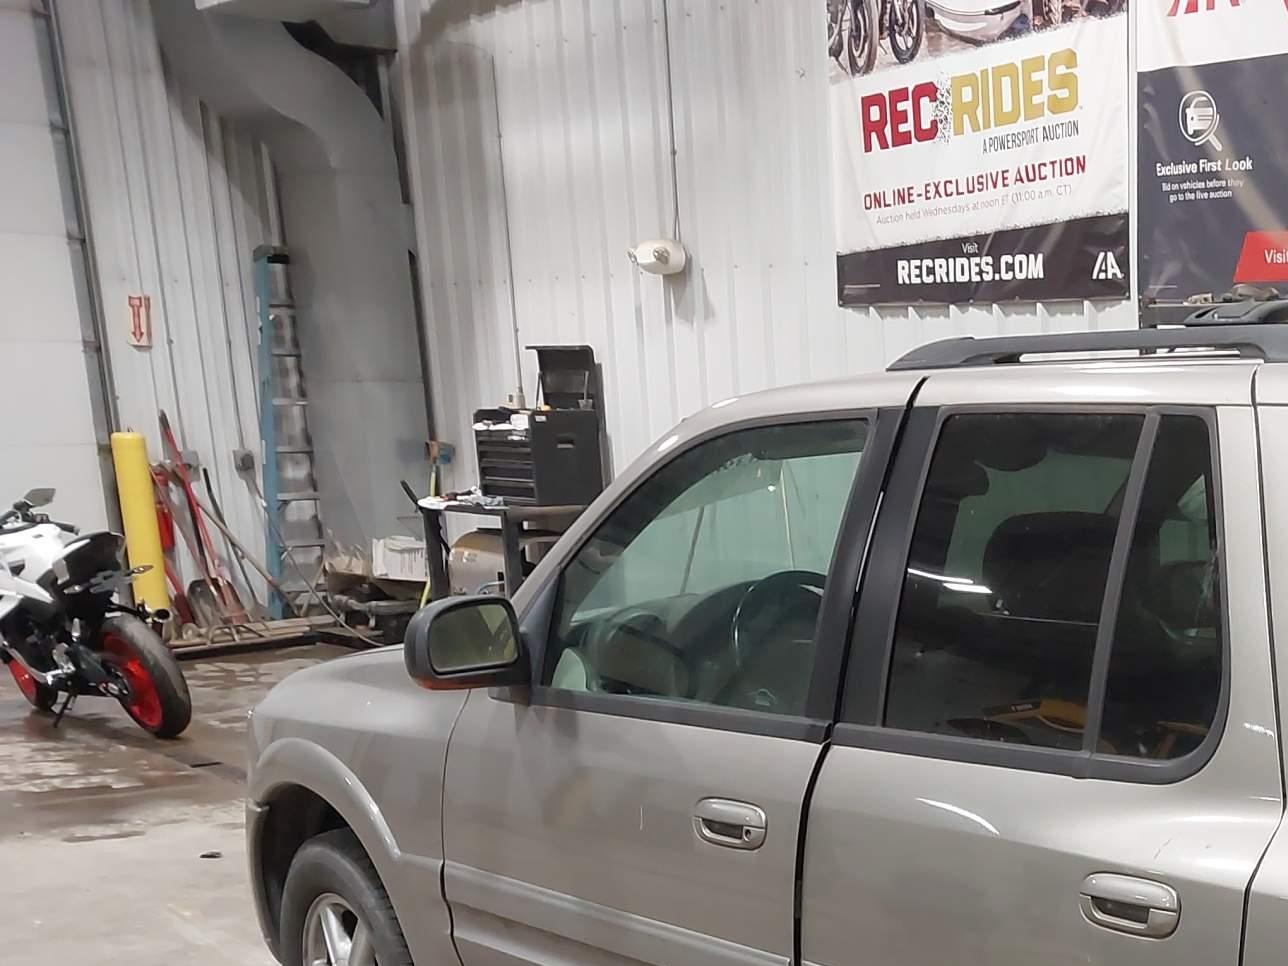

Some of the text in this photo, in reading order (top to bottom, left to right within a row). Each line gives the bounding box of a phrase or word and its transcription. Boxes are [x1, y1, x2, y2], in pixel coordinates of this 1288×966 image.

[861, 47, 1079, 153] REC RIDES
[988, 127, 1040, 153] POWERSPORT
[1042, 119, 1080, 143] AUCTION
[1156, 155, 1254, 177] Exclusive First Look
[864, 155, 1087, 211] ONLINE-EXCLUSIVE AUCTION
[1161, 178, 1245, 192] Bid on vehicles before they
[1168, 189, 1233, 204] go to the live auction
[876, 213, 904, 226] Auction
[922, 200, 970, 216] Wednesdays
[980, 198, 1000, 209] noon
[961, 242, 979, 254] Visit
[897, 252, 1044, 285] RECRIDES.COM
